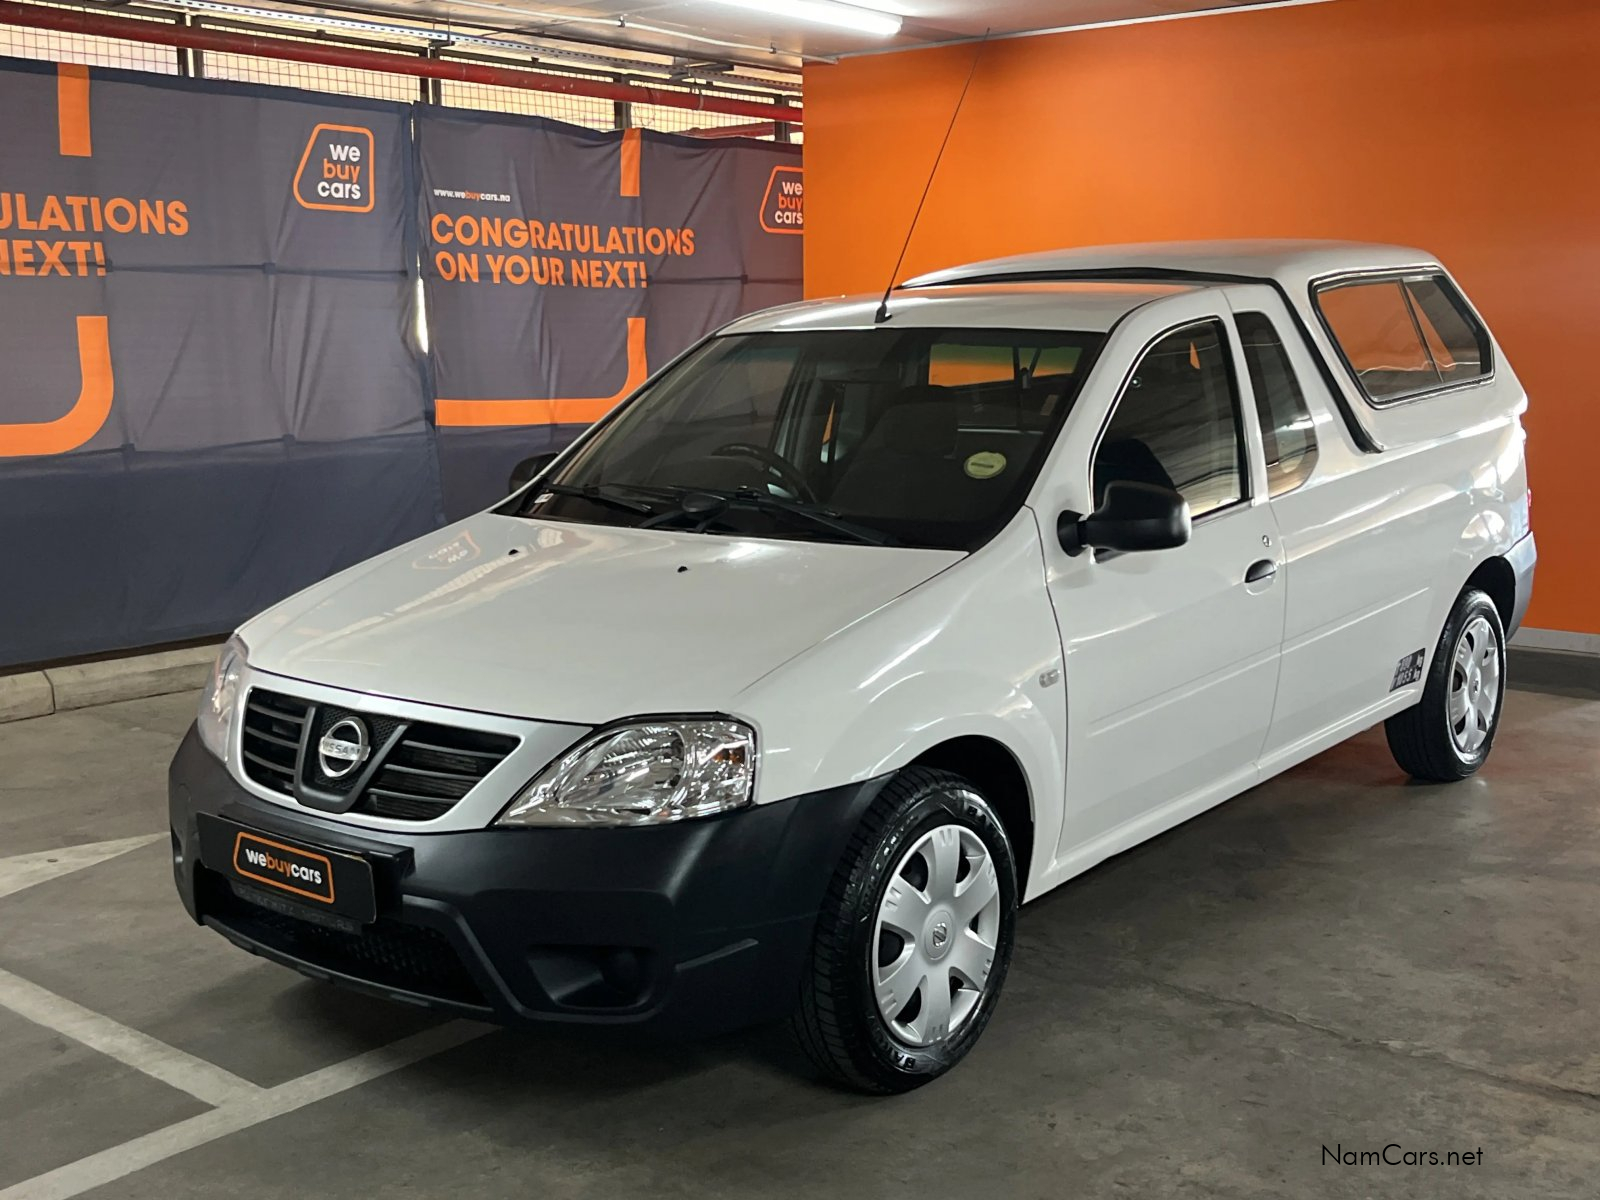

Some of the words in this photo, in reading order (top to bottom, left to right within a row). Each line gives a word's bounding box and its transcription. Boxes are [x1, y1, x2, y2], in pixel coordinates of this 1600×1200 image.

[329, 144, 360, 162] we
[323, 158, 360, 183] buy
[317, 181, 361, 200] cars
[433, 187, 511, 203] www.webuycars.na
[782, 181, 803, 195] we
[778, 192, 803, 211] buy
[774, 210, 803, 224] cars
[431, 213, 695, 256] CONGRATULATIONS
[435, 250, 479, 283] ON
[487, 254, 565, 286] YOUR
[572, 258, 647, 288] NEXT!
[245, 848, 322, 884] webuycars
